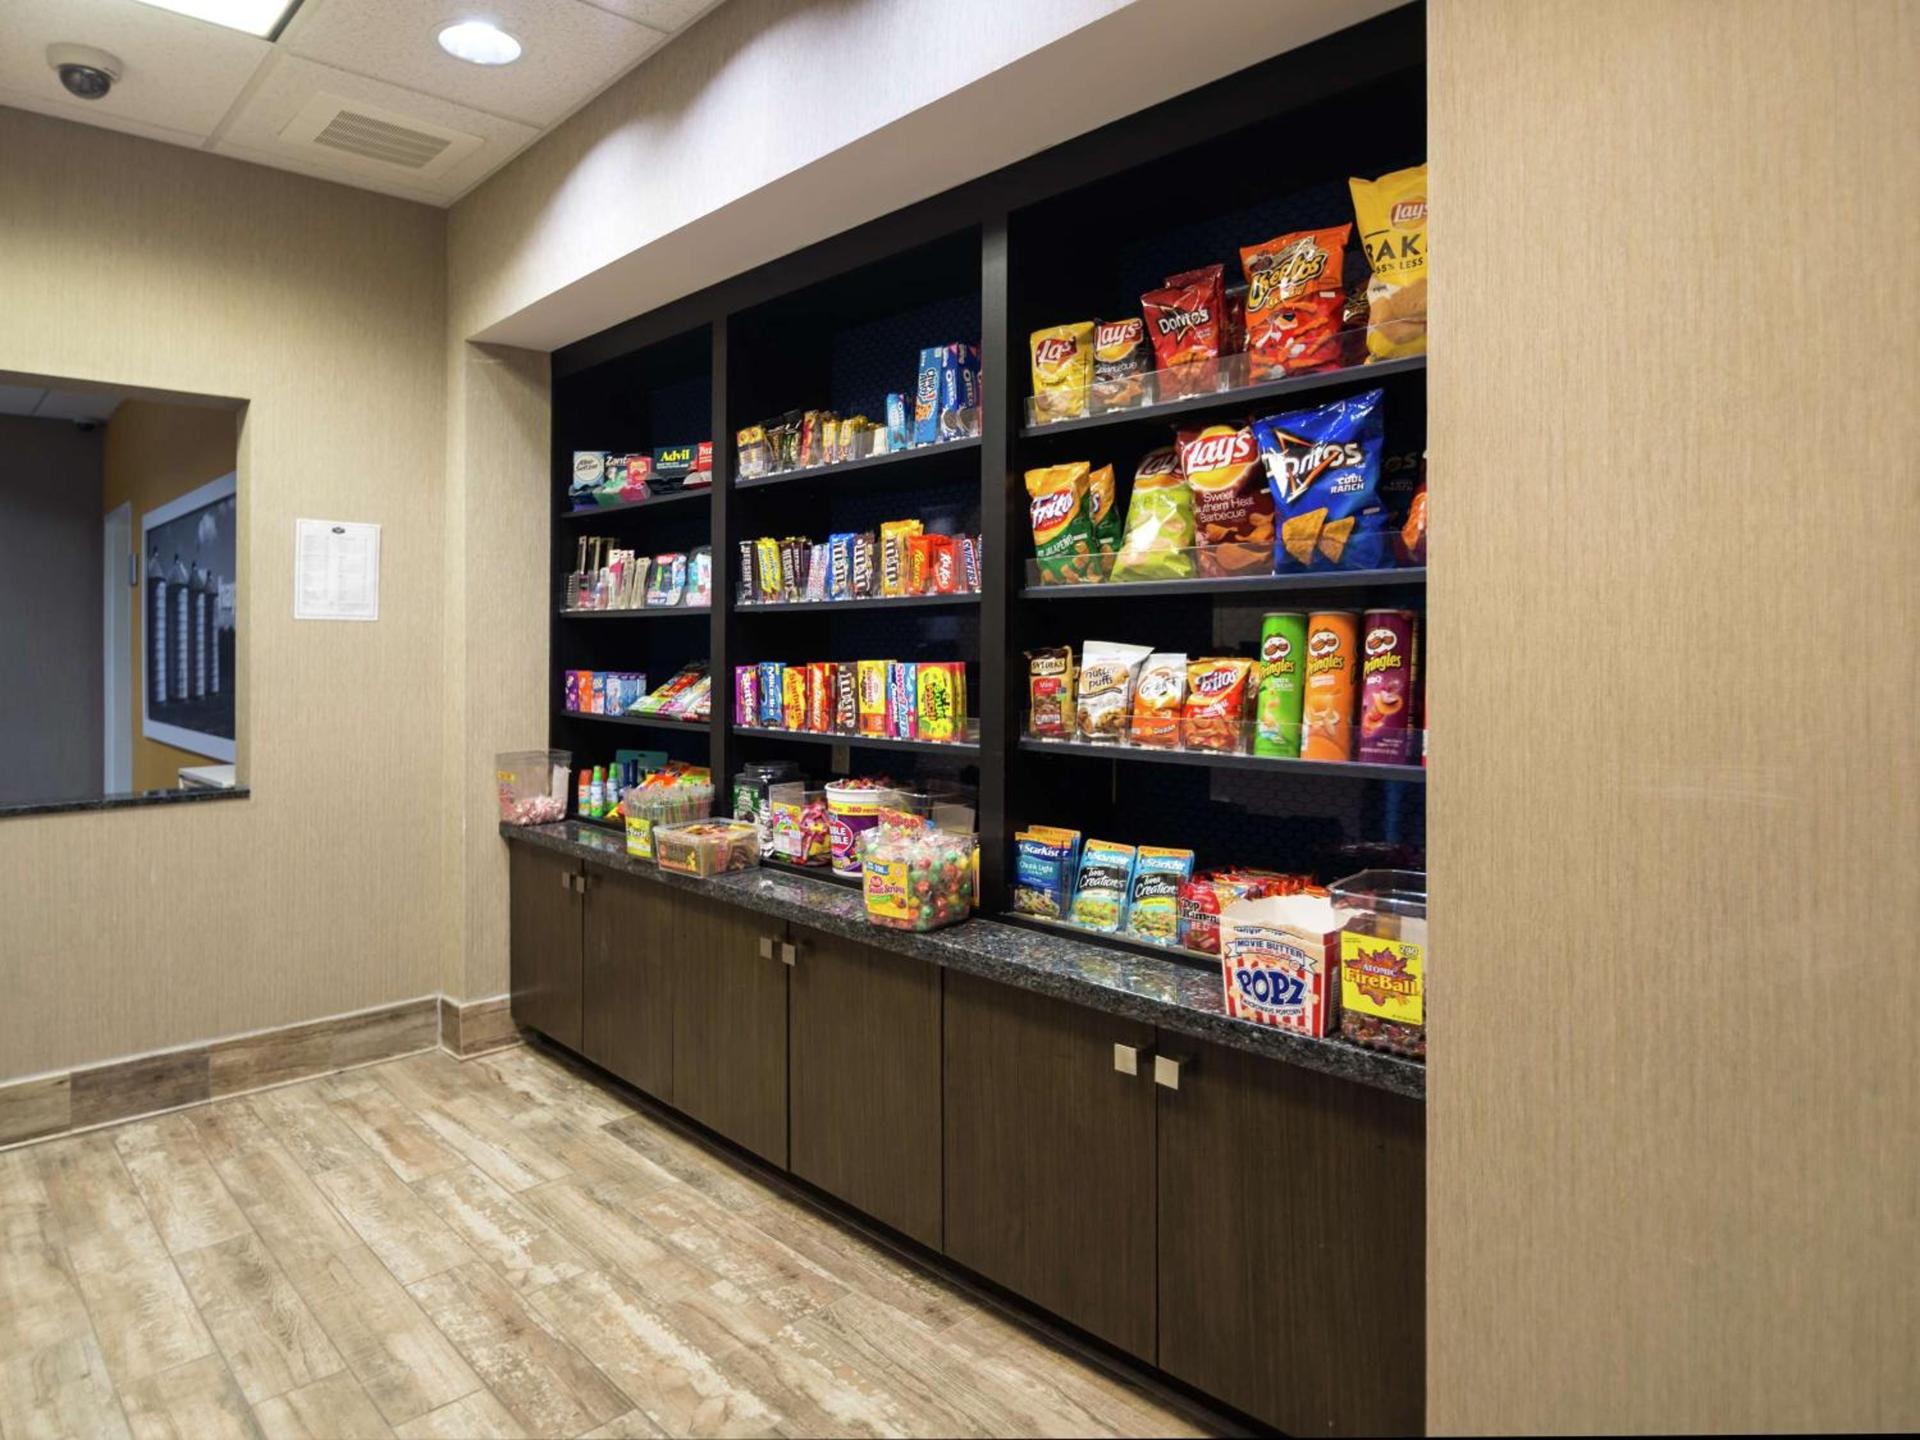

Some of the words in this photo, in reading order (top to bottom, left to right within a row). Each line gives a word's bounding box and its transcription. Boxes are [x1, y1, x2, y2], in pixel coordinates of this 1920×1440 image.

[1400, 257, 1424, 270] LESS
[1158, 308, 1210, 335] Doritos
[661, 449, 690, 462] Advil
[1203, 489, 1234, 504] Sweet
[1331, 482, 1365, 495] RANCH
[1200, 508, 1247, 523] Barbecue
[1259, 659, 1295, 678] Pringles
[1308, 654, 1344, 674] Pringles
[1364, 652, 1402, 674] Pringles
[1079, 874, 1126, 890] Creations
[1267, 942, 1304, 959] BUTTER
[1236, 969, 1305, 1005] POPZ
[1344, 966, 1418, 995] FireBall
